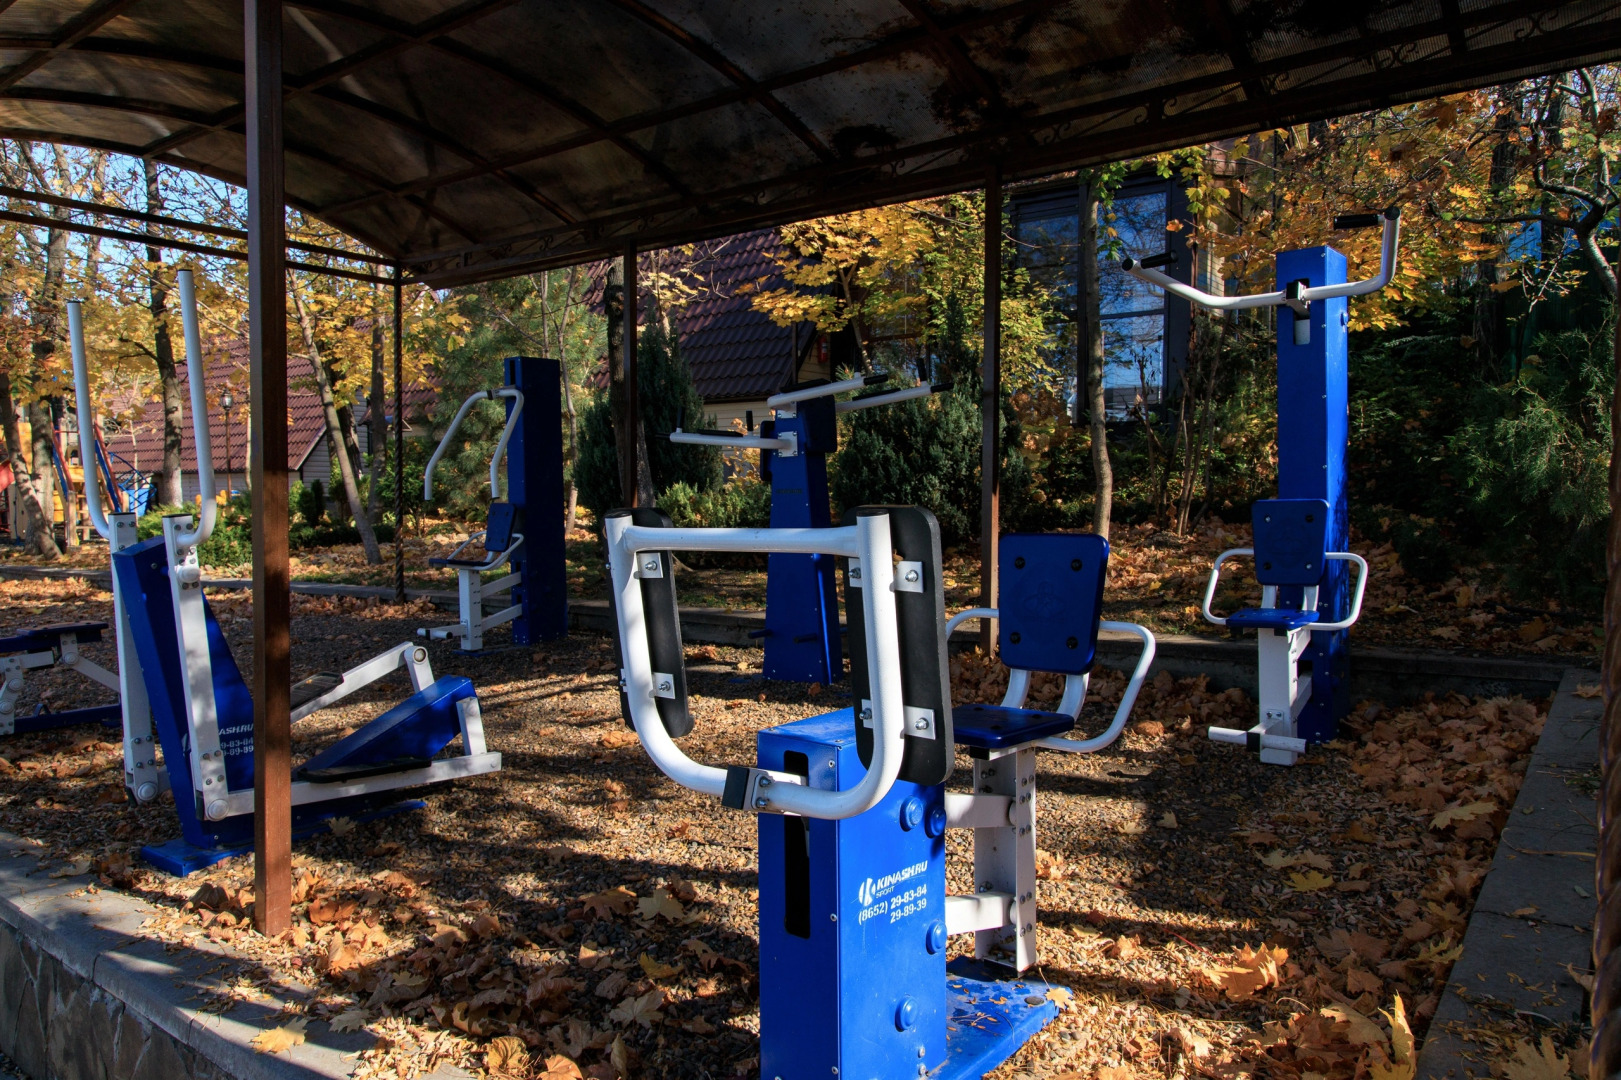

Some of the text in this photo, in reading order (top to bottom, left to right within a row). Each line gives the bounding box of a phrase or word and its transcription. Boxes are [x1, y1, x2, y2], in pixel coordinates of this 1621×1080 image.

[218, 723, 254, 735] ASH.RU
[876, 885, 895, 899] SPORT
[858, 883, 927, 925] (8652) 29-83-84
[890, 898, 927, 924] 29-89-39
